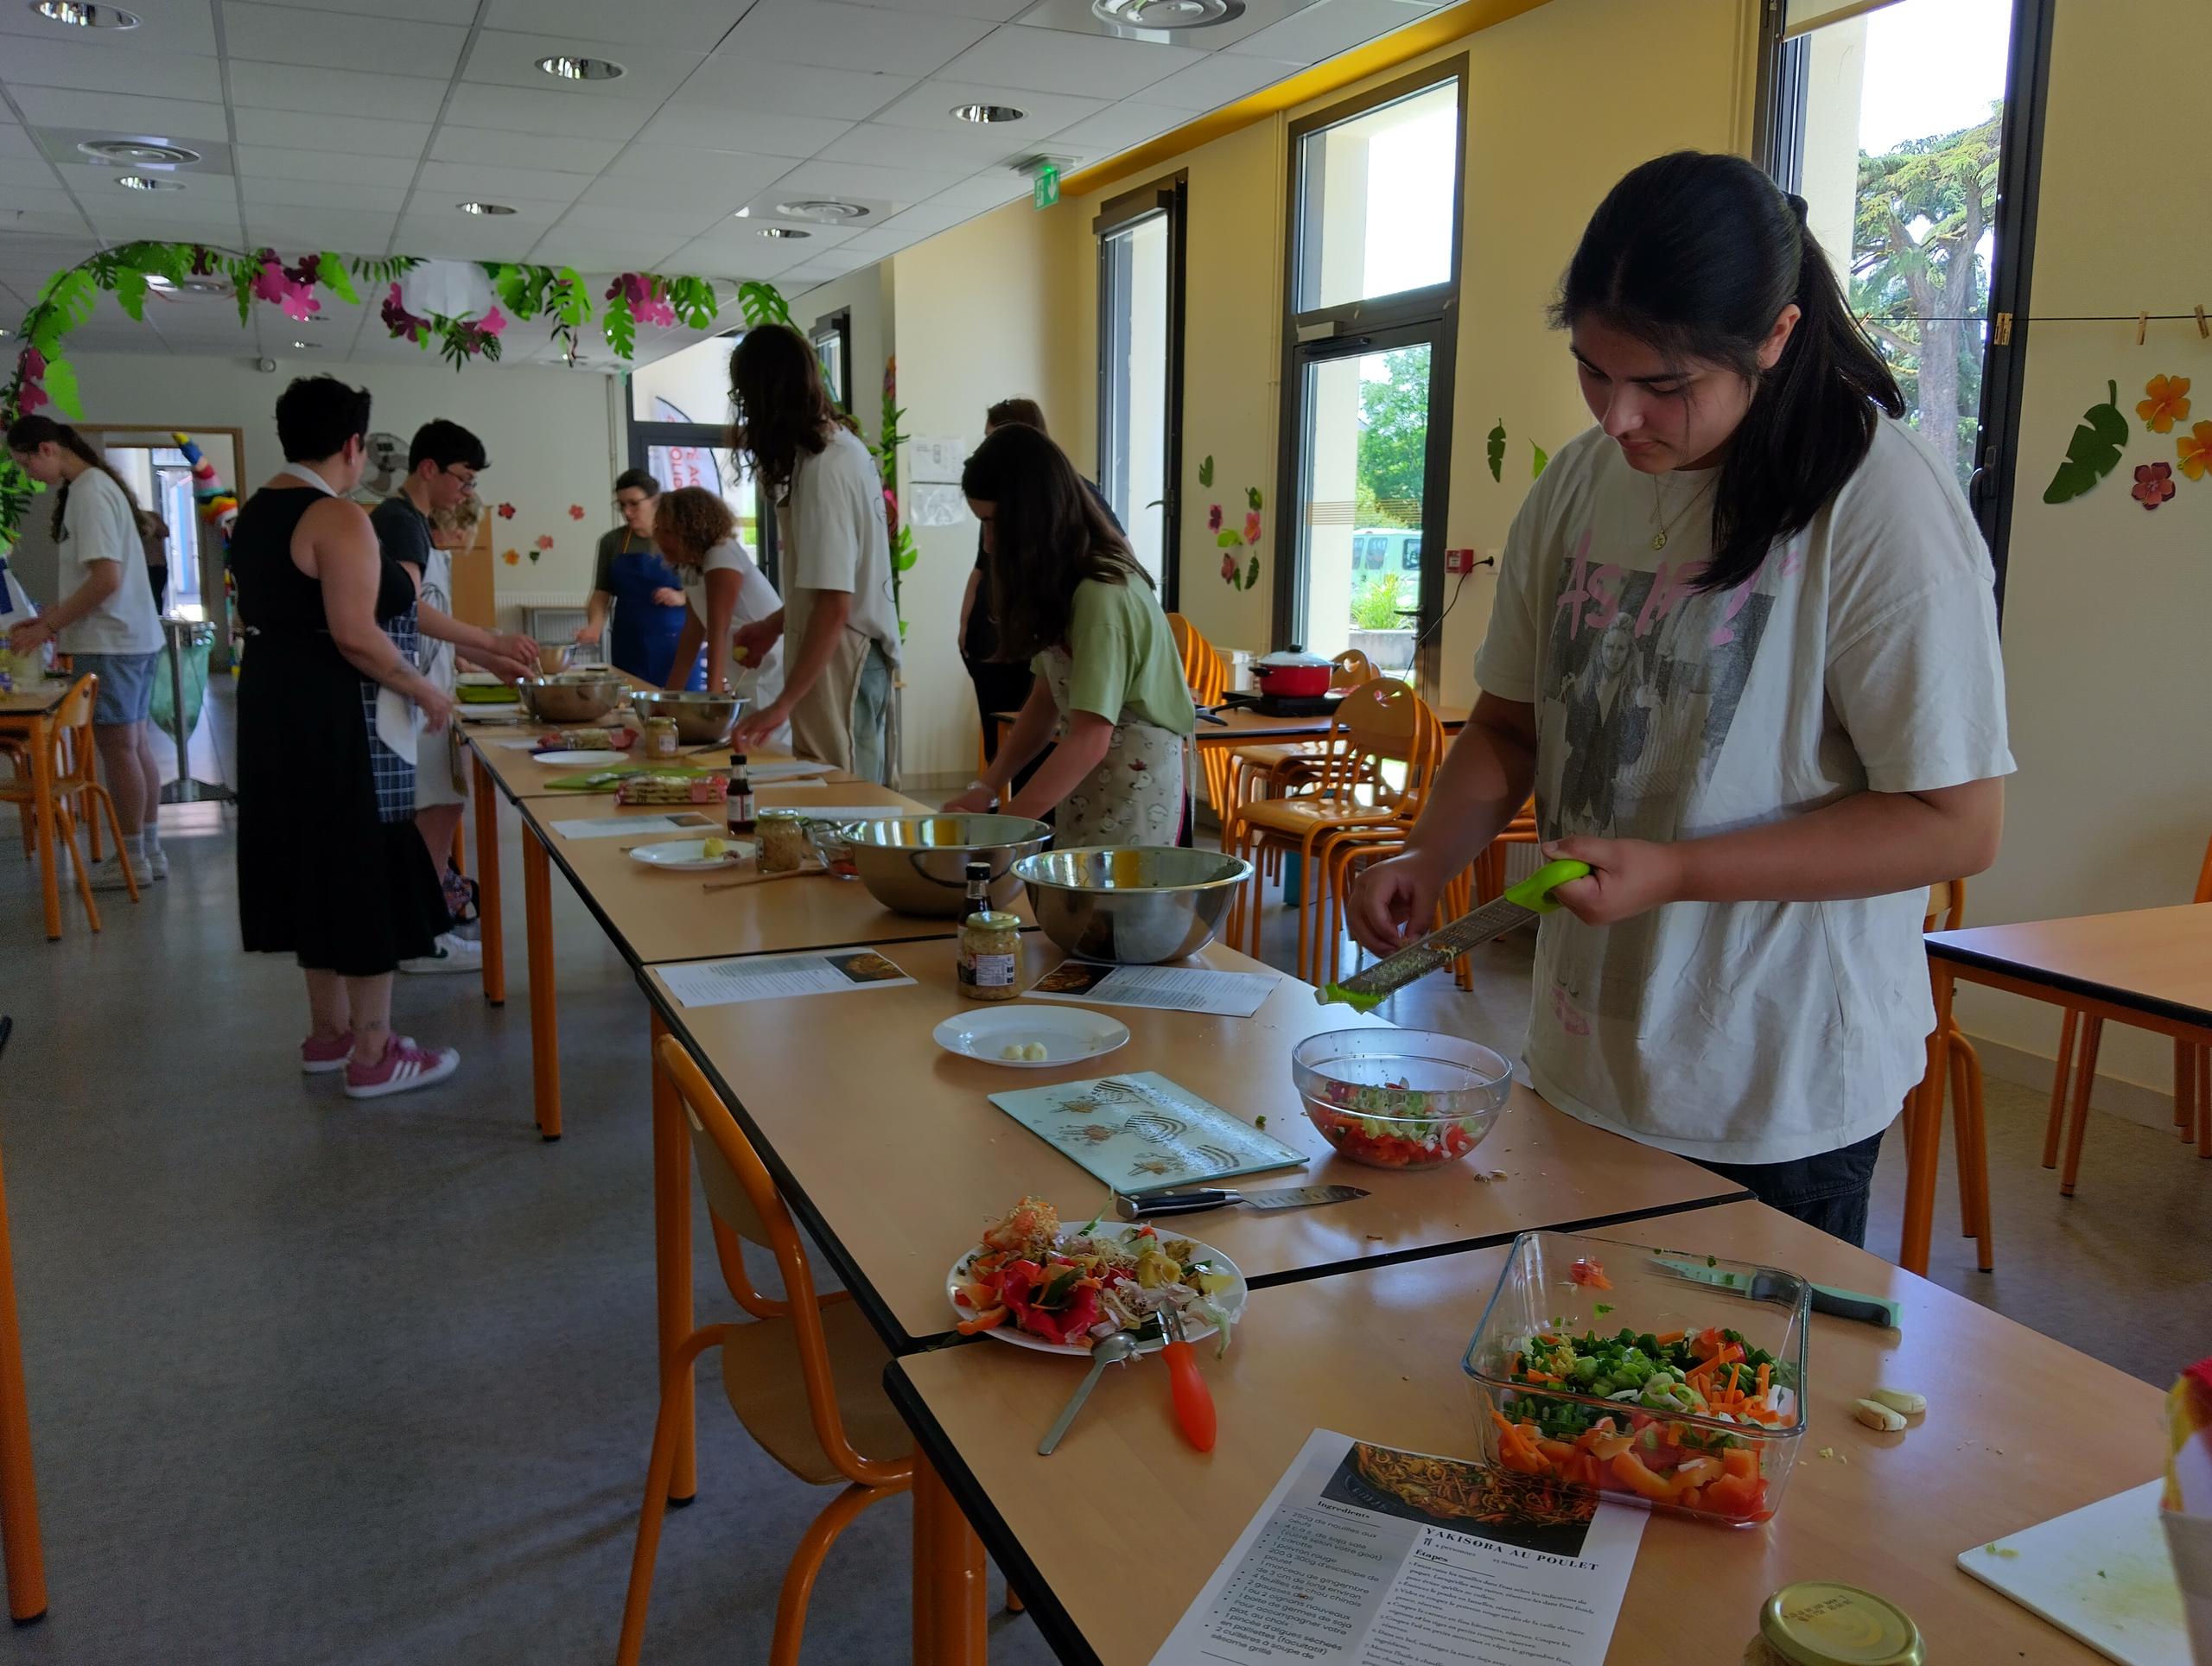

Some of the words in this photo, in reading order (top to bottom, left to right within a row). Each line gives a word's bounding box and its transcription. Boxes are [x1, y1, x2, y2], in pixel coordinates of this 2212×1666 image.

[1556, 528, 1622, 640] AS
[1291, 1511, 1313, 1523] 250g
[1317, 1500, 1370, 1518] Ingredients
[1281, 1536, 1313, 1549] carotte
[1309, 1537, 1332, 1548] selon
[1333, 1543, 1357, 1554] votre
[1328, 1536, 1347, 1545] soja
[1427, 1527, 1502, 1553] YAKISOBA
[1536, 1555, 1596, 1570] POULET
[1263, 1554, 1293, 1565] poulet
[1268, 1547, 1286, 1556] 200
[1294, 1555, 1316, 1566] 300g
[1275, 1543, 1310, 1556] poivron
[1310, 1552, 1338, 1563] rouge
[1264, 1561, 1306, 1577] morceau
[1319, 1577, 1370, 1593] gingembre
[1254, 1581, 1291, 1595] gousses
[1259, 1574, 1290, 1587] feuilles
[1304, 1587, 1328, 1598] chou
[1329, 1594, 1362, 1607] chinois
[1305, 1580, 1326, 1591] long
[1327, 1587, 1361, 1599] environ
[1268, 1593, 1305, 1606] oignons
[1305, 1603, 1351, 1620] nouveaux
[1229, 1614, 1262, 1627] pincée
[1233, 1599, 1255, 1608] Pour
[1255, 1606, 1321, 1627] accompagner
[1322, 1625, 1347, 1635] votre
[1264, 1616, 1289, 1626] choix
[1281, 1605, 1317, 1618] germes
[1332, 1619, 1352, 1629] soja
[1210, 1633, 1248, 1648] sésame
[1232, 1624, 1275, 1640] paillettes
[1270, 1643, 1300, 1656] soupe
